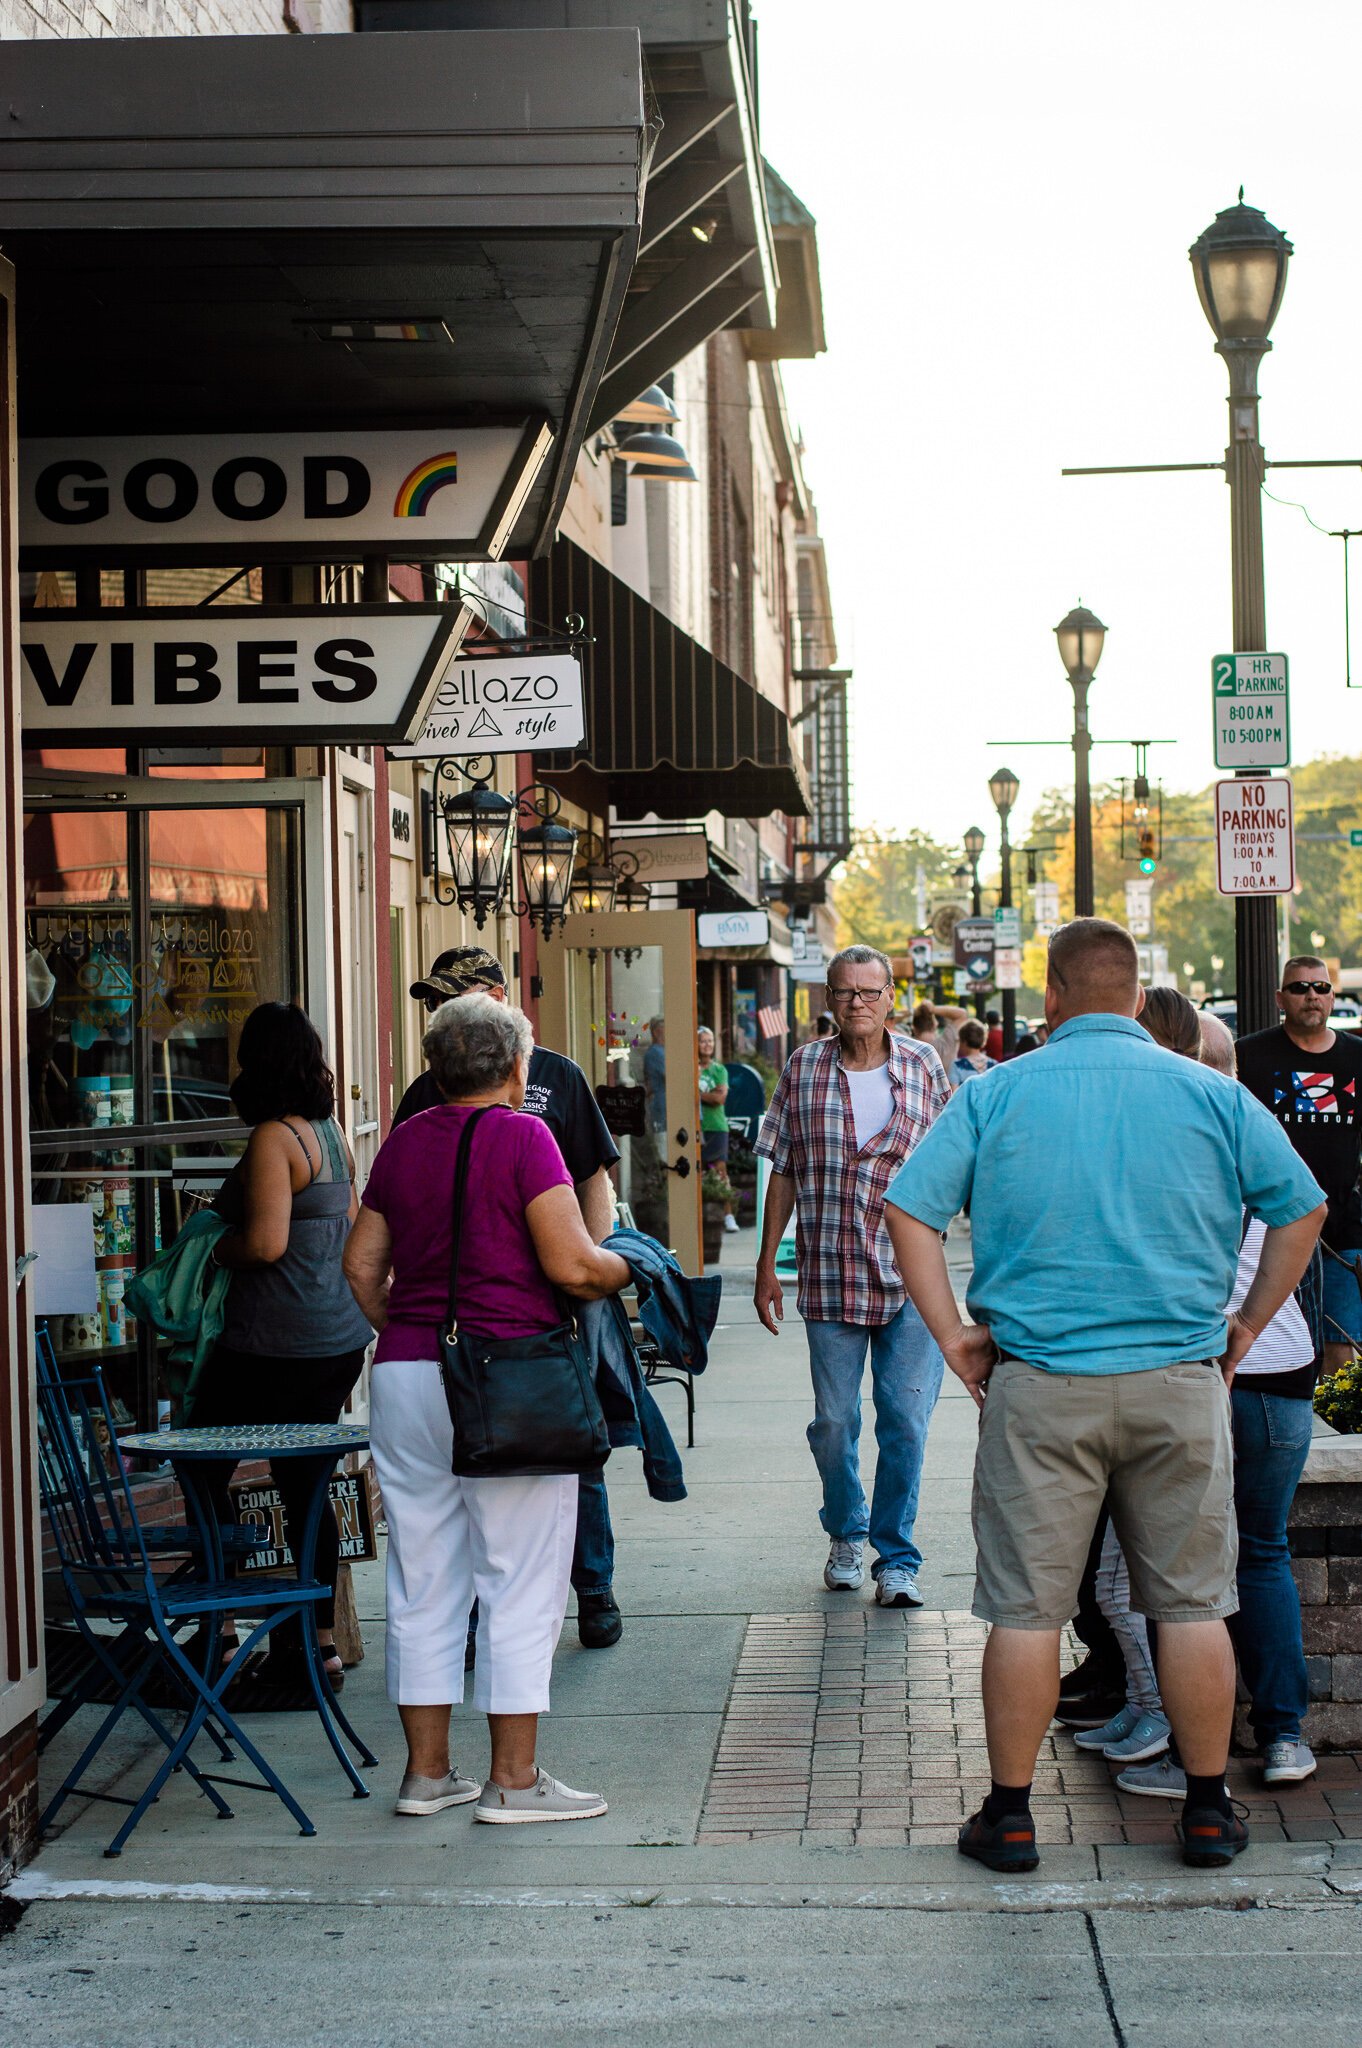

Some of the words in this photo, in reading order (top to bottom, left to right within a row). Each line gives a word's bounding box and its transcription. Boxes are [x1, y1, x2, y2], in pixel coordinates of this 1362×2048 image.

[35, 455, 371, 525] GOOD
[21, 638, 378, 706] VIBES
[1253, 659, 1271, 673] HR
[1216, 662, 1233, 691] 2
[1238, 677, 1284, 692] PARKING
[515, 712, 557, 740] style
[1222, 729, 1235, 743] TO
[1242, 785, 1265, 807] NO
[1222, 809, 1286, 830] PARKING
[1234, 832, 1275, 844] FRIDAYS
[1233, 847, 1253, 859] 1:00
[1257, 846, 1278, 858] A.M.
[1250, 861, 1262, 873] TO
[1233, 876, 1255, 888] 7:00
[1259, 875, 1280, 887] A.M.
[185, 919, 253, 953] bellazo
[717, 922, 749, 934] BMM
[963, 940, 993, 952] Center
[238, 1490, 282, 1509] COME
[245, 1550, 278, 1569] AND
